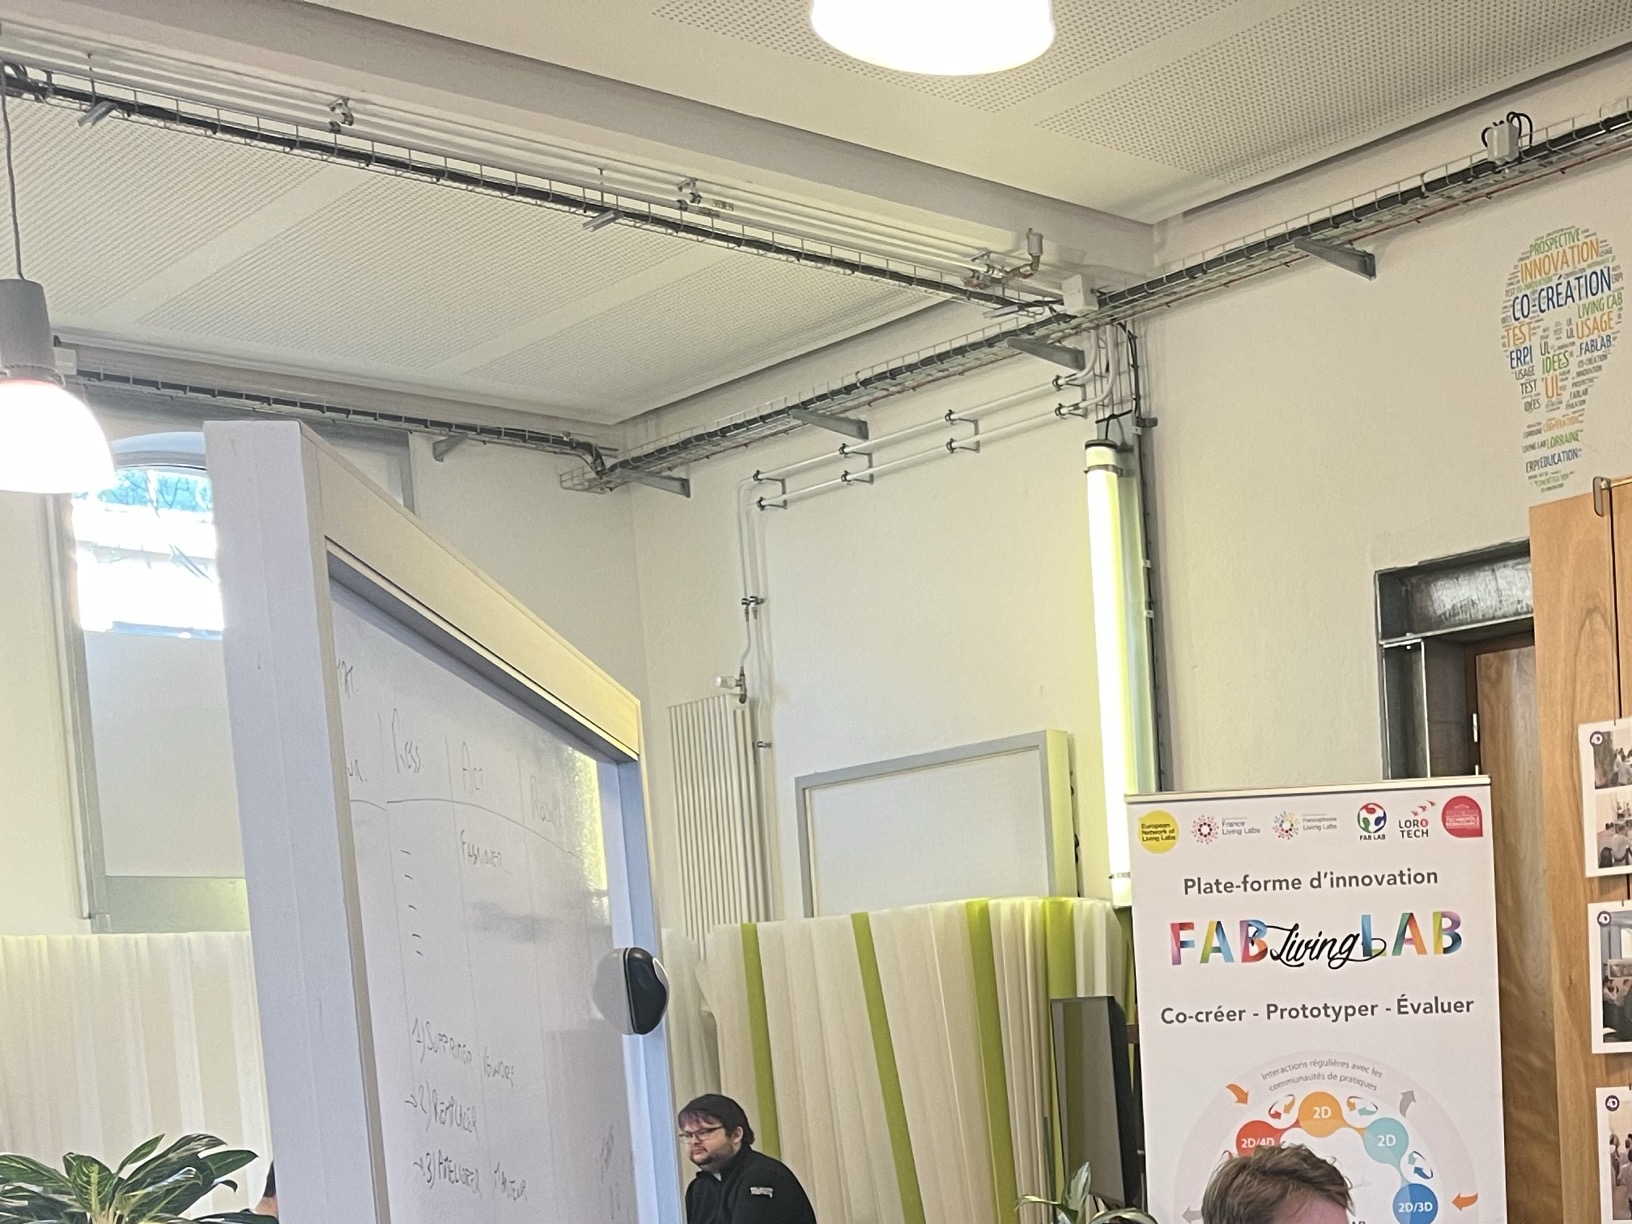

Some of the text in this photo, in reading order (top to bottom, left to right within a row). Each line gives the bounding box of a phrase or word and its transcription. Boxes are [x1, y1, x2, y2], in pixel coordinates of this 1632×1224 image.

[1530, 228, 1580, 256] PROSPECTIVE
[1520, 237, 1600, 283] INNOVATION
[1512, 266, 1611, 321] CO-CRÉATION
[1578, 292, 1623, 319] LIVING LAB
[1504, 322, 1533, 348] TEST
[1575, 311, 1614, 340] USAGE
[1540, 341, 1551, 356] UL
[1580, 334, 1612, 357] FABLAB
[1510, 345, 1533, 370] ERPI
[1542, 350, 1570, 374] IDEES
[1515, 365, 1535, 381] USAGE
[1520, 379, 1538, 395] TEST
[1544, 374, 1562, 399] UL
[1547, 430, 1580, 450] LORRAINE
[1540, 448, 1579, 469] EDUCATION
[1222, 820, 1246, 828] France
[1222, 828, 1243, 836] Living
[1303, 823, 1338, 832] Living Labs
[1399, 818, 1429, 829] LORO
[1400, 829, 1429, 839] TECH
[1184, 867, 1438, 896] Plate-forme d'innovation
[1170, 910, 1463, 970] FAB Living LAB
[1160, 1006, 1246, 1025] Co-créer
[1266, 1000, 1379, 1022] Prototyper
[1396, 994, 1474, 1016] Évaluer
[1261, 1058, 1383, 1081] Interactions régulières avec les
[1269, 1072, 1378, 1092] communautés de pratiques
[1313, 1107, 1332, 1119] 2D
[1241, 1138, 1275, 1149] 2D/4D
[1378, 1134, 1397, 1147] 2D
[1398, 1202, 1433, 1213] 2D/3D
